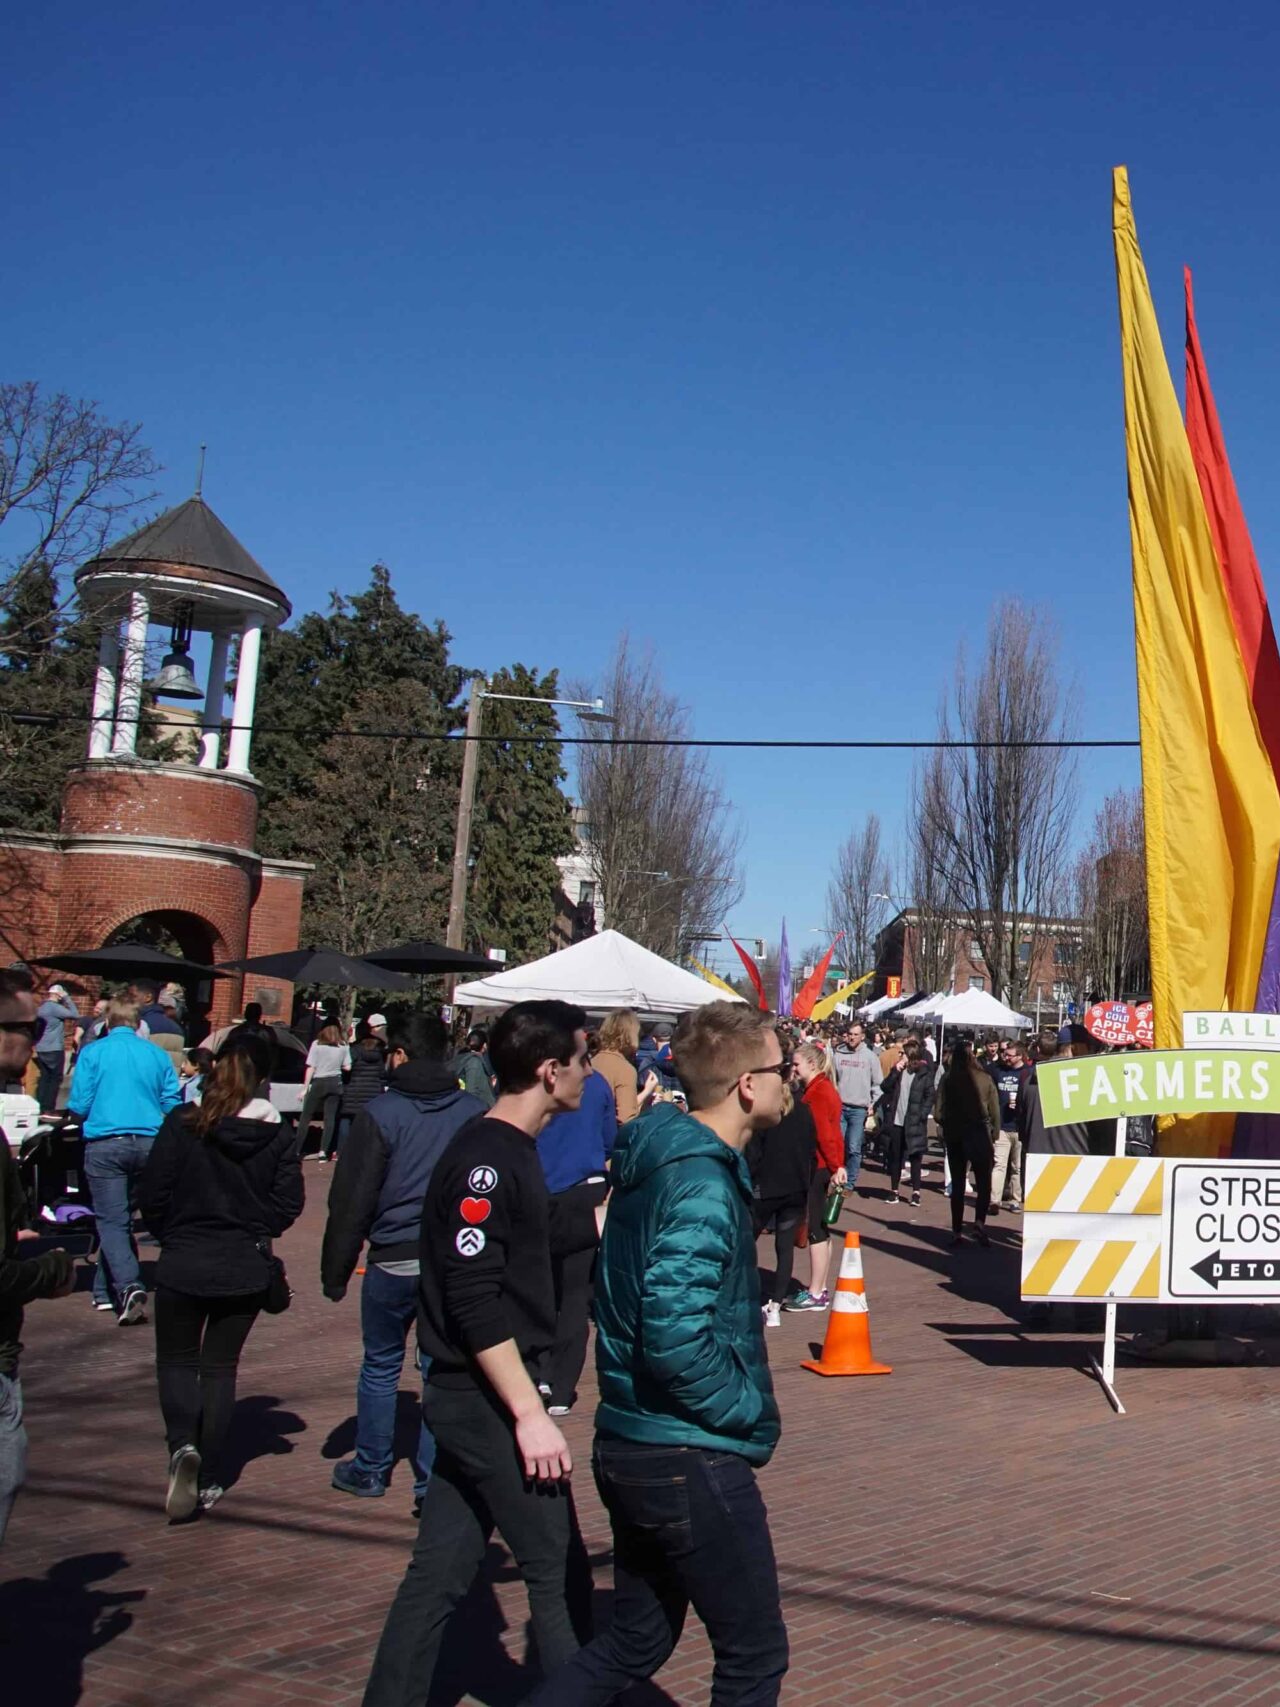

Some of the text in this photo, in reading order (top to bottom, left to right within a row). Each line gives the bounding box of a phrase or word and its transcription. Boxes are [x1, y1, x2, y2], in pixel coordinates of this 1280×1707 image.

[1112, 1004, 1127, 1014] ICE
[1105, 1011, 1130, 1023] COLD
[1091, 1027, 1136, 1042] CIDER
[1059, 1060, 1270, 1110] FARMERS
